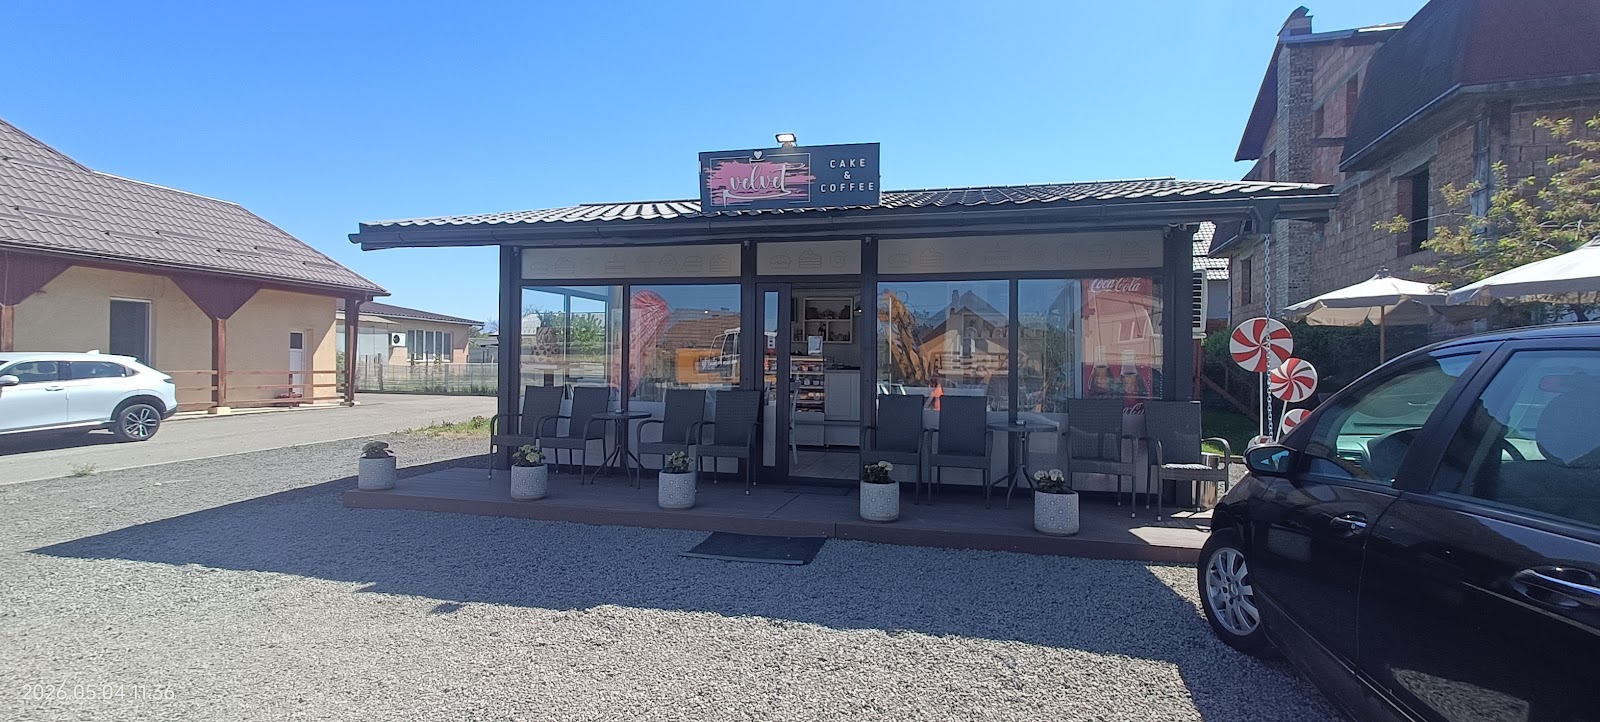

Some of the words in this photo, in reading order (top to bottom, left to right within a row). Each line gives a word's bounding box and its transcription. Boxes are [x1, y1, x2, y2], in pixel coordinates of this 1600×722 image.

[829, 158, 866, 169] CAKE
[724, 159, 802, 197] velvet
[843, 170, 851, 180] &
[820, 181, 875, 193] COFFEE
